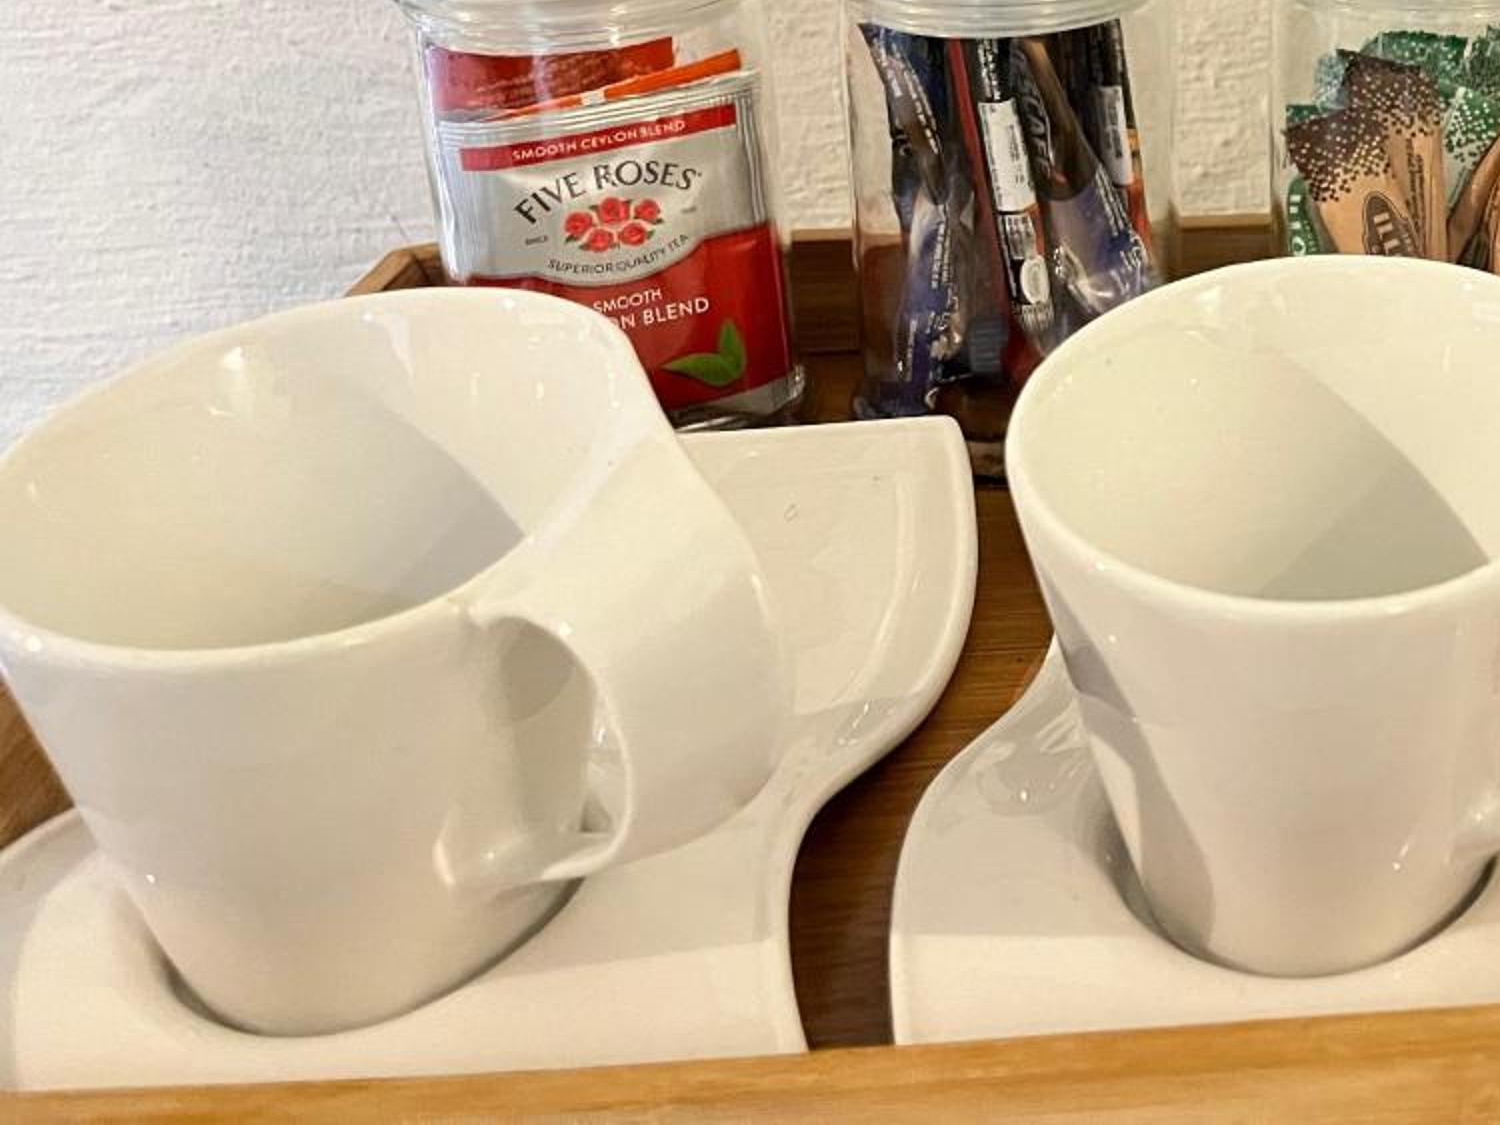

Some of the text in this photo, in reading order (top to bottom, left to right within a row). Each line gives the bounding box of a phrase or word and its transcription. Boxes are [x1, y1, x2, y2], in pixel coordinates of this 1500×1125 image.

[512, 119, 685, 162] SMOOTH CEYLON BLEND
[513, 159, 698, 225] FIVE ROSES
[547, 233, 689, 274] SUPERIOR QUALITY TEA
[593, 287, 663, 314] SMOOTH
[642, 297, 710, 325] BLEND
